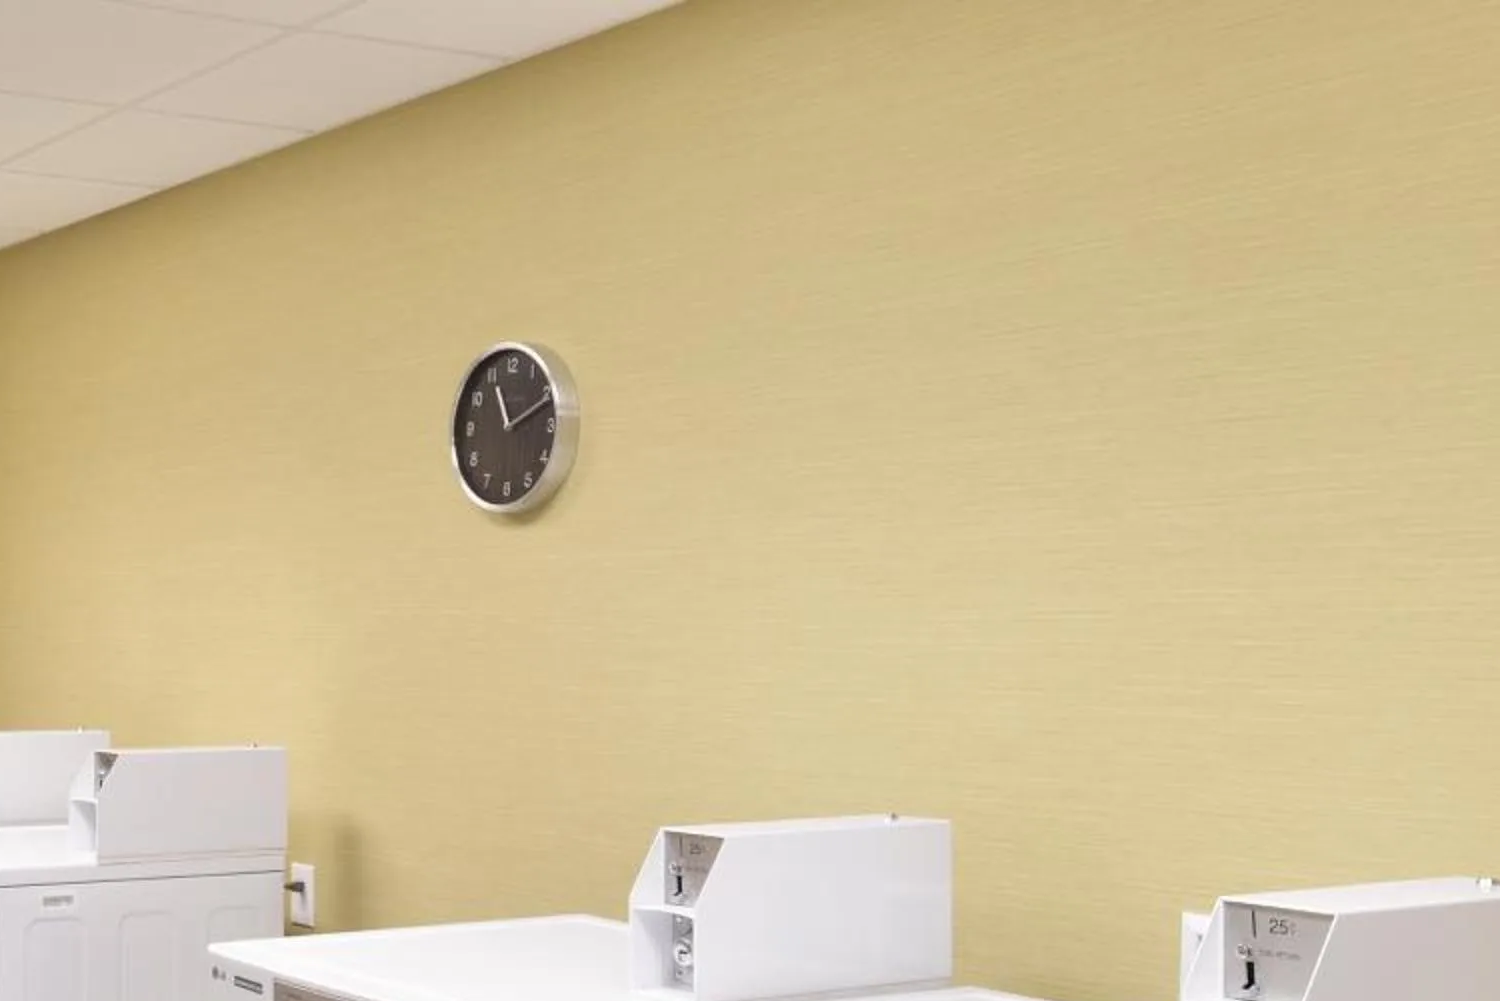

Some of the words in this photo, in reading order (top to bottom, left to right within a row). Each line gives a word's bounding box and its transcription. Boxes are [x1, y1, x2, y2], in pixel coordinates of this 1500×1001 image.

[507, 357, 519, 373] 12
[530, 364, 535, 379] 1
[487, 368, 497, 382] 11
[471, 391, 483, 407] 10
[542, 385, 551, 401] 2
[466, 421, 475, 437] 9
[547, 417, 556, 433] 3
[469, 452, 478, 467] 8
[539, 449, 549, 465] 4
[483, 473, 492, 489] 7
[523, 471, 533, 488] 5
[503, 481, 511, 497] 6
